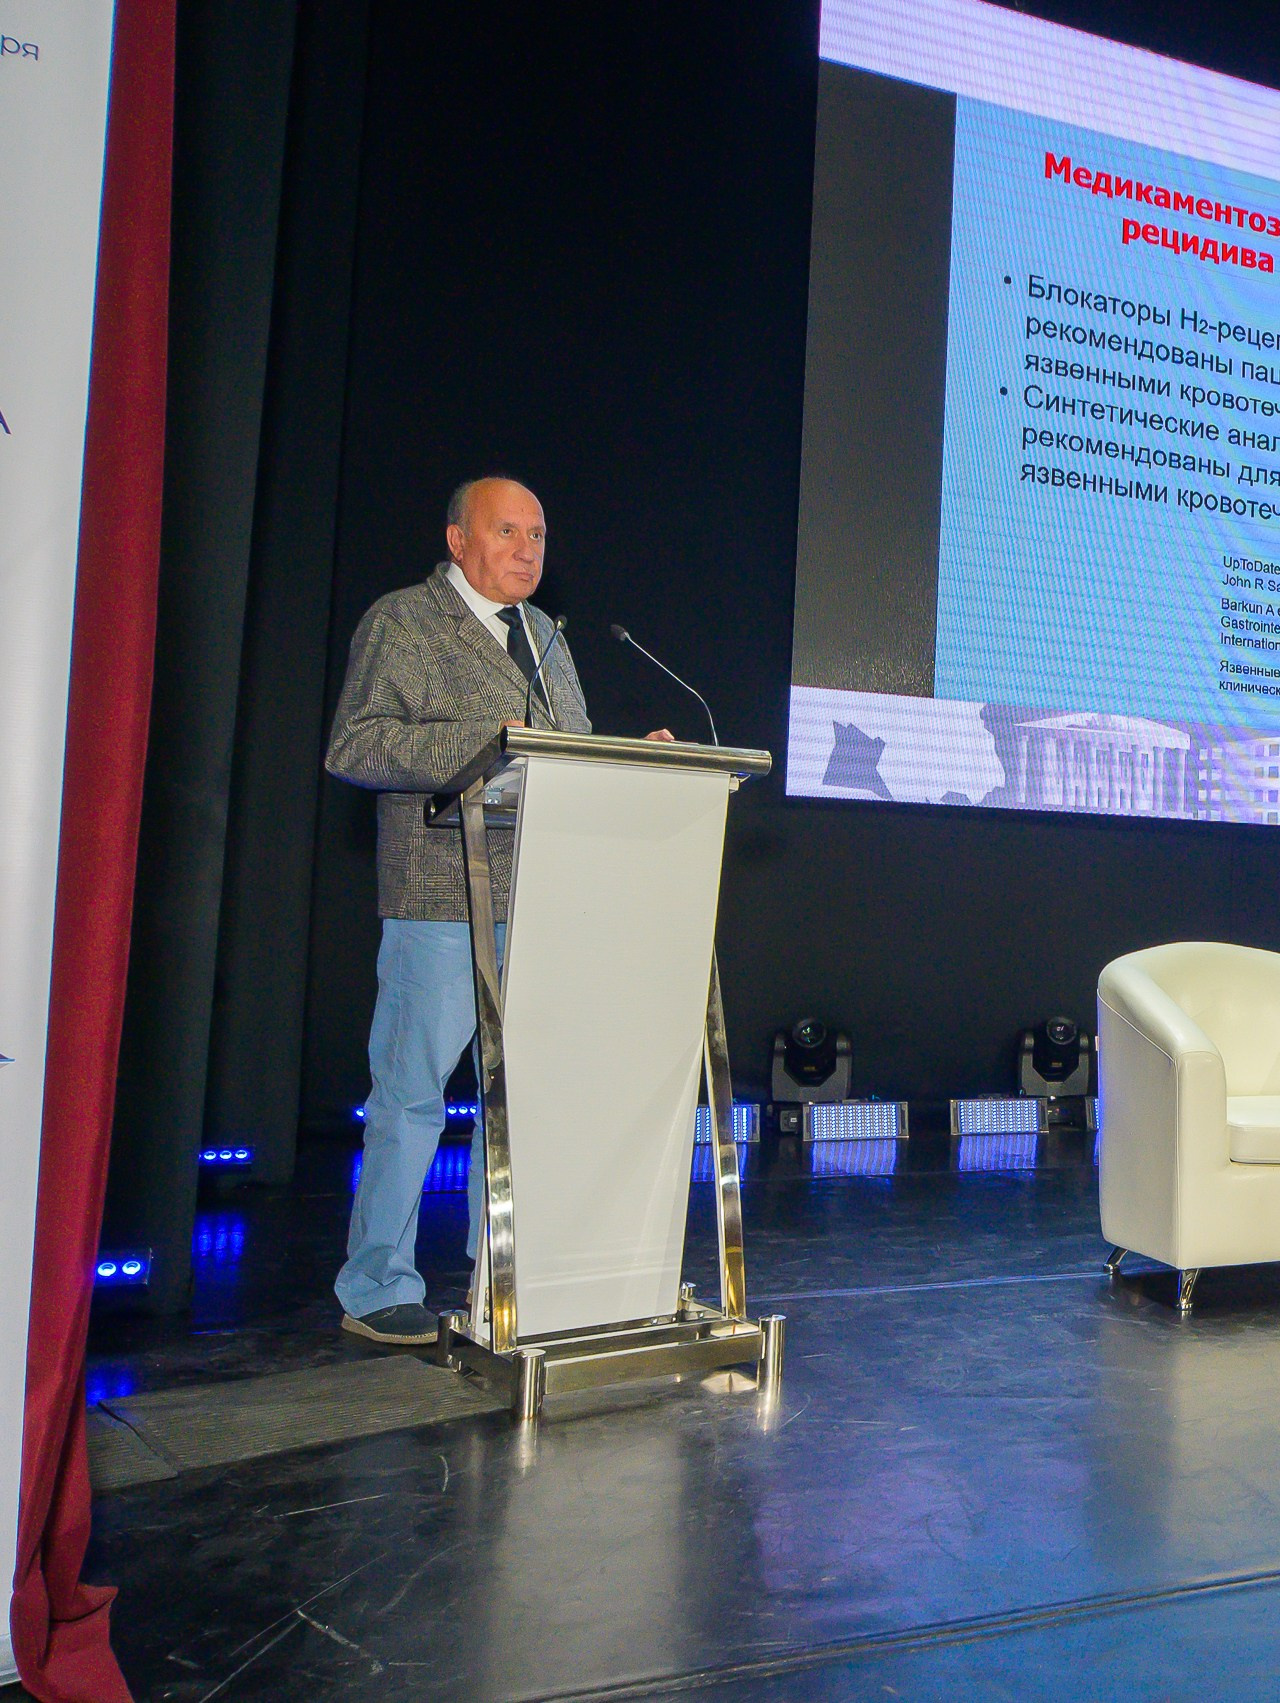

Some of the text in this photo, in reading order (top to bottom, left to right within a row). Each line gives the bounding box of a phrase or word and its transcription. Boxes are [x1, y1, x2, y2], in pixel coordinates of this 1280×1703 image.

[1122, 217, 1274, 273] рецидива
[1028, 274, 1171, 326] Блокаторы
[1026, 315, 1233, 375] рекомендованы
[1024, 354, 1171, 397] язвенными
[1023, 384, 1219, 441] Синтетические
[1022, 426, 1230, 478] рекомендованы
[1020, 463, 1168, 504] язвенными
[1222, 574, 1251, 588] John
[1254, 578, 1264, 590] R
[1223, 556, 1280, 575] UpToDate
[1221, 597, 1263, 615] Barkun
[1265, 604, 1275, 616] A
[1219, 660, 1280, 678] Язвенные
